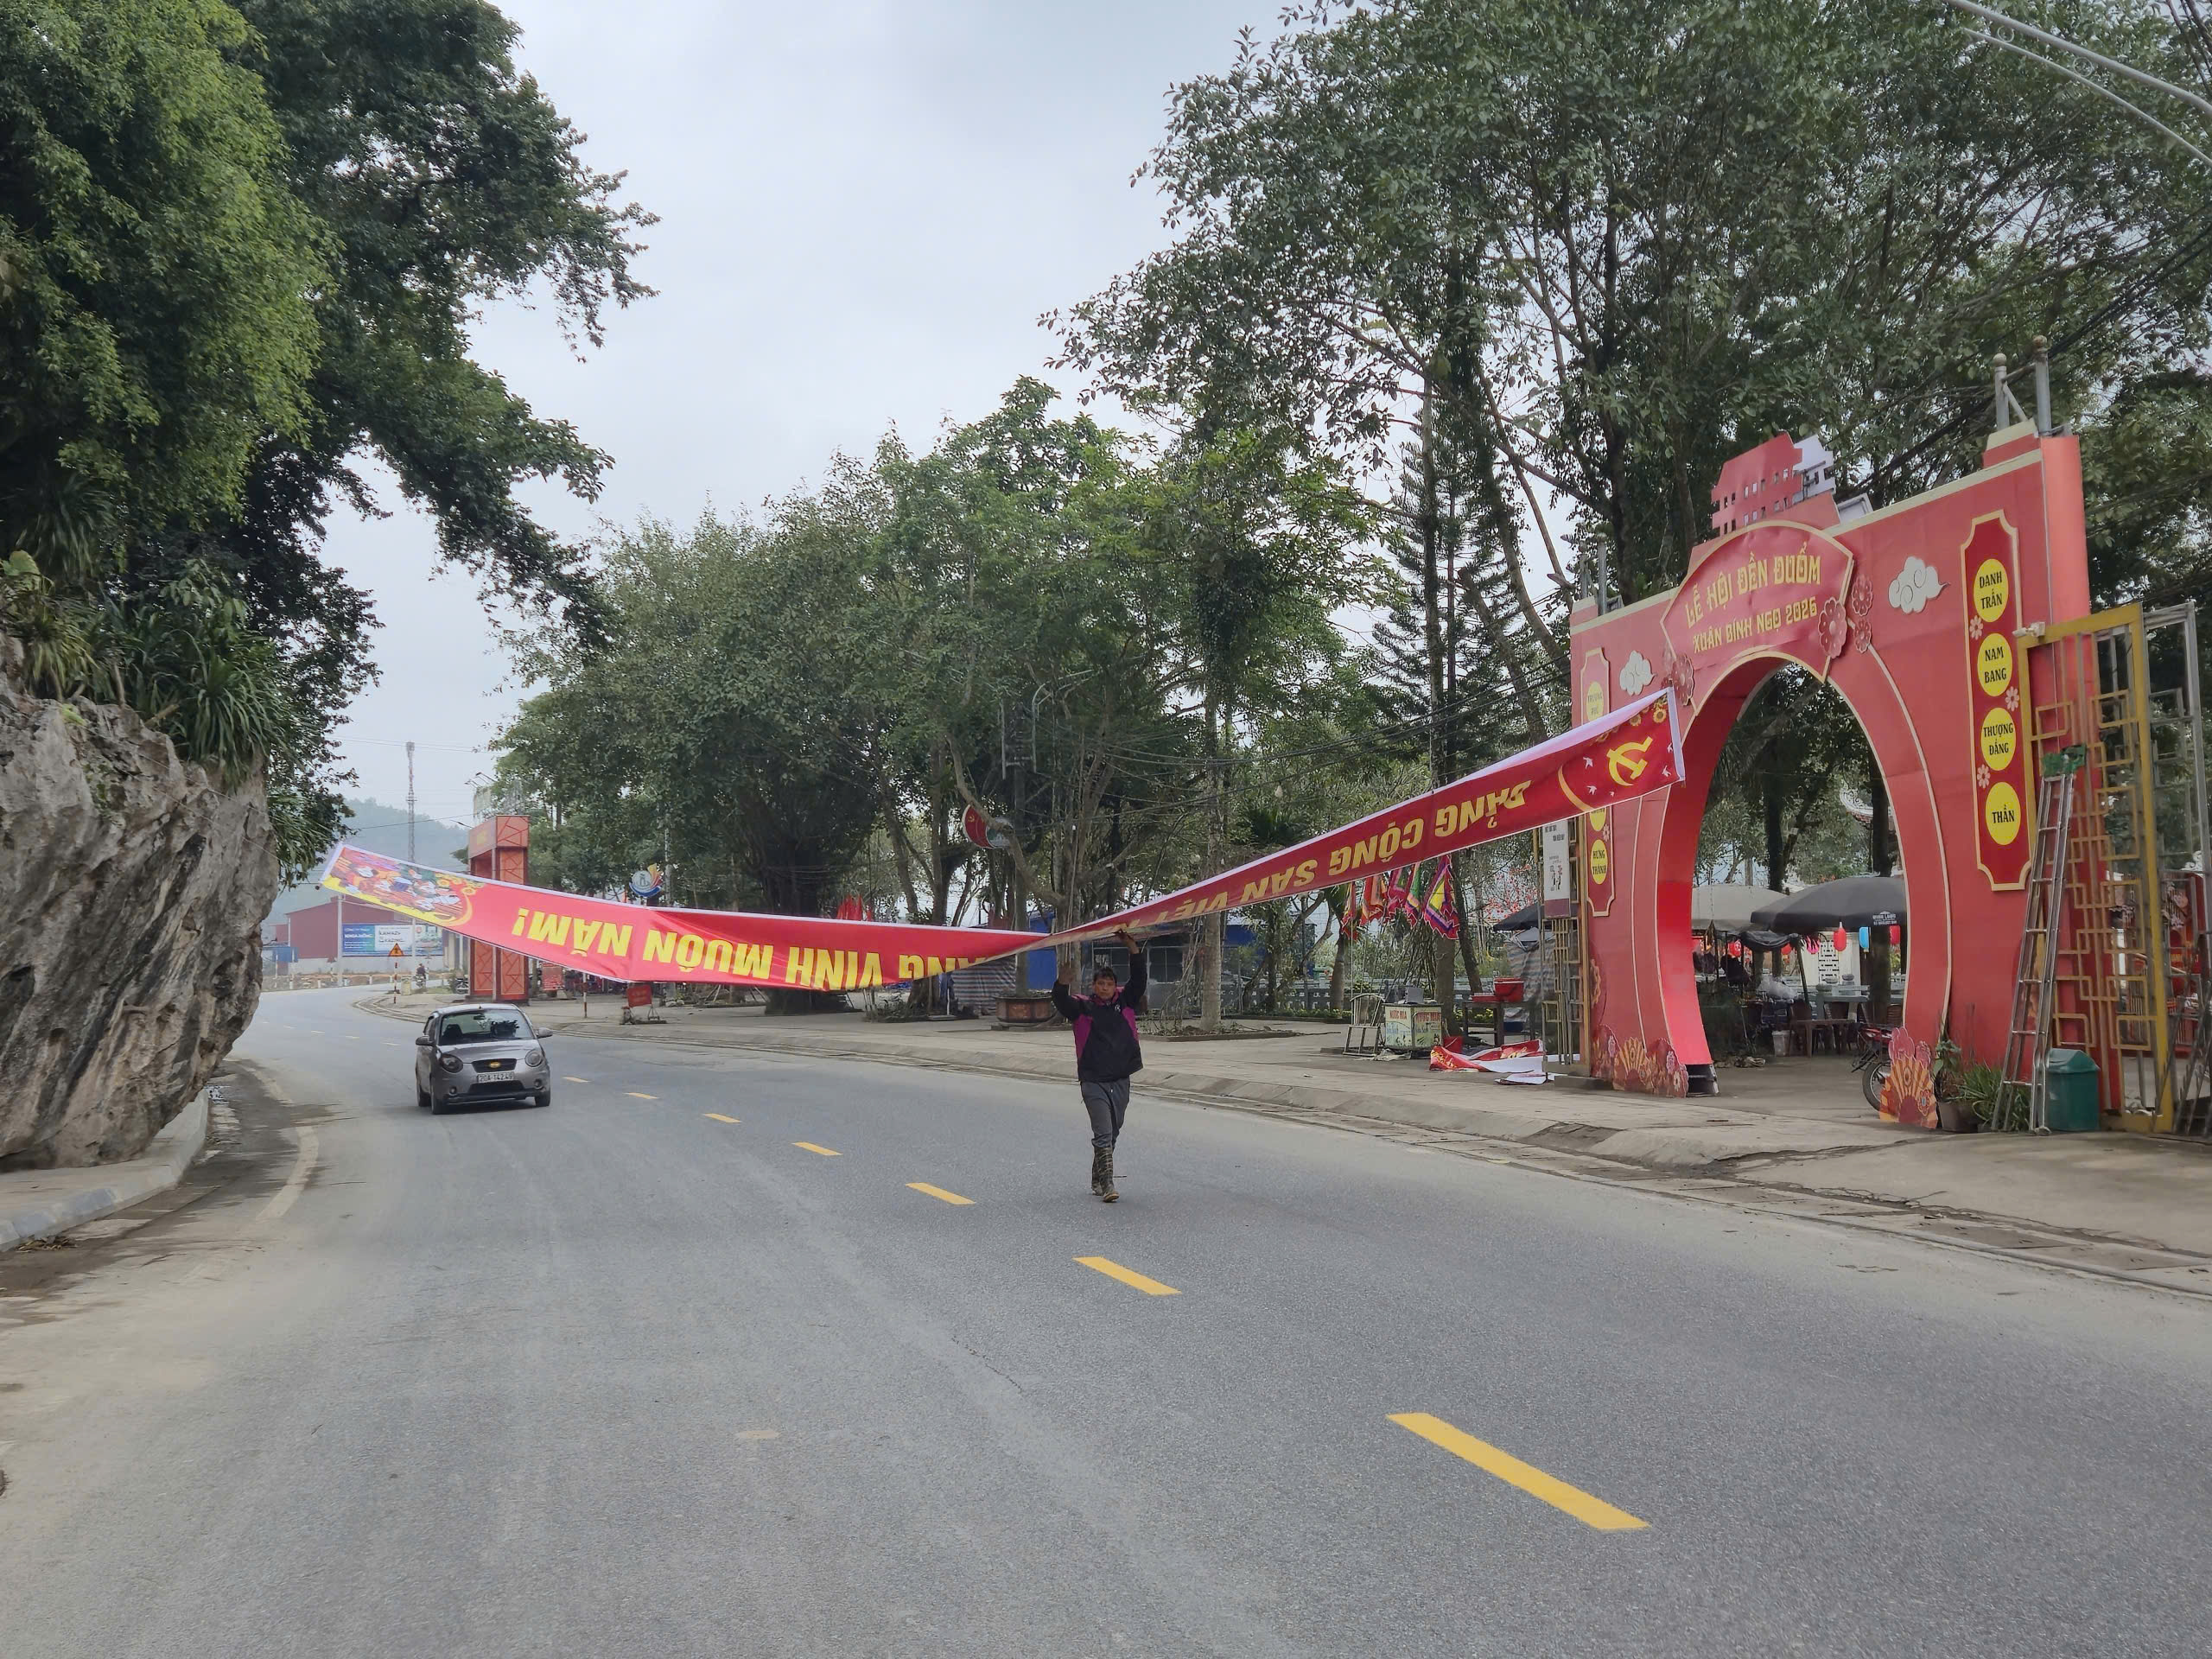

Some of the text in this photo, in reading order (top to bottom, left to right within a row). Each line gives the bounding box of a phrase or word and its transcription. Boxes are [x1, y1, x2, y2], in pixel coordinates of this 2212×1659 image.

[1686, 541, 1821, 629] LỄ HỘI ĐỀN ĐUỔM
[1979, 570, 2003, 588] DANH
[1694, 596, 1817, 654] XUÂN BÍNH NGỌ 2026
[1984, 667, 2006, 683] BANG
[1985, 646, 2004, 662] NAM
[1983, 722, 2013, 737] THƯỢNG
[1329, 817, 1425, 876] CỘNG
[512, 907, 633, 957] NĂM!
[642, 928, 773, 979] MUÔN
[785, 945, 883, 989] VINH
